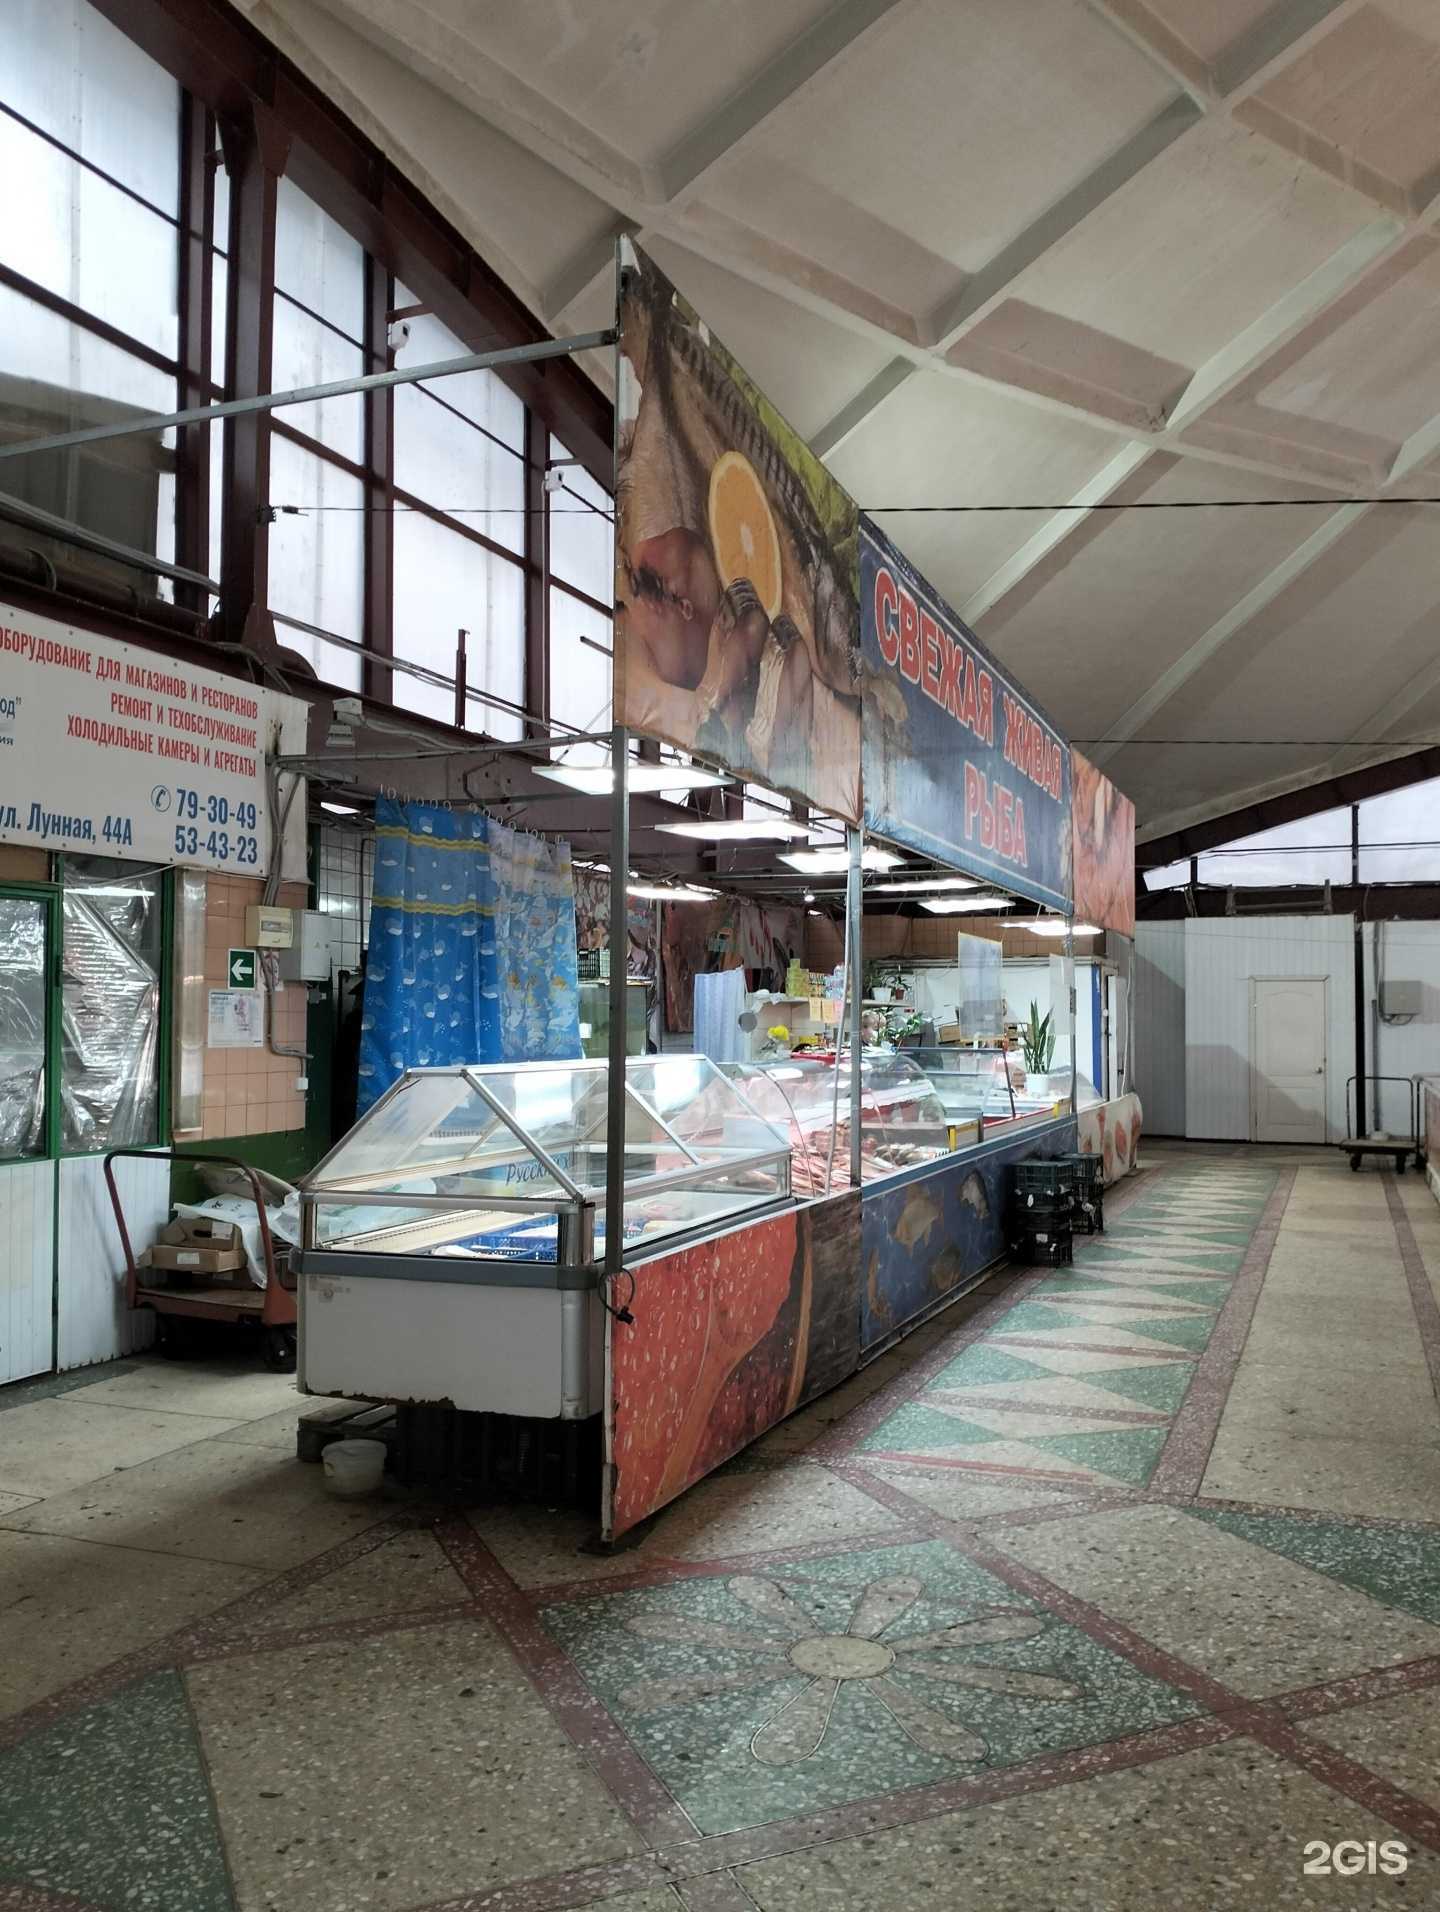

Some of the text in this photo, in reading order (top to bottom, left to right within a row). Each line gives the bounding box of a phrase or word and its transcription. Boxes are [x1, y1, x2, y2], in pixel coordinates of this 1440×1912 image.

[96, 656, 121, 682] ДЛЯ
[126, 664, 187, 699] МАГАЗИНОВ
[191, 683, 198, 703] И
[202, 686, 258, 720] РЕСТОРАНОВ
[874, 567, 1063, 803] СВЕЖАЯ ЖИВАЯ
[67, 714, 257, 777] ХОЛОДИЛЬНЫЕ КАМЕРЫ И АГРЕГАТЫ
[111, 692, 257, 749] РЕМОНТ И ТЕХОБСЛУЖИВАНИЕ
[27, 803, 96, 845] Лунная,
[102, 815, 132, 846] 44А
[176, 788, 257, 829] 79-30-49
[963, 759, 1029, 868] РЫБА
[175, 825, 258, 864] 53-43-23
